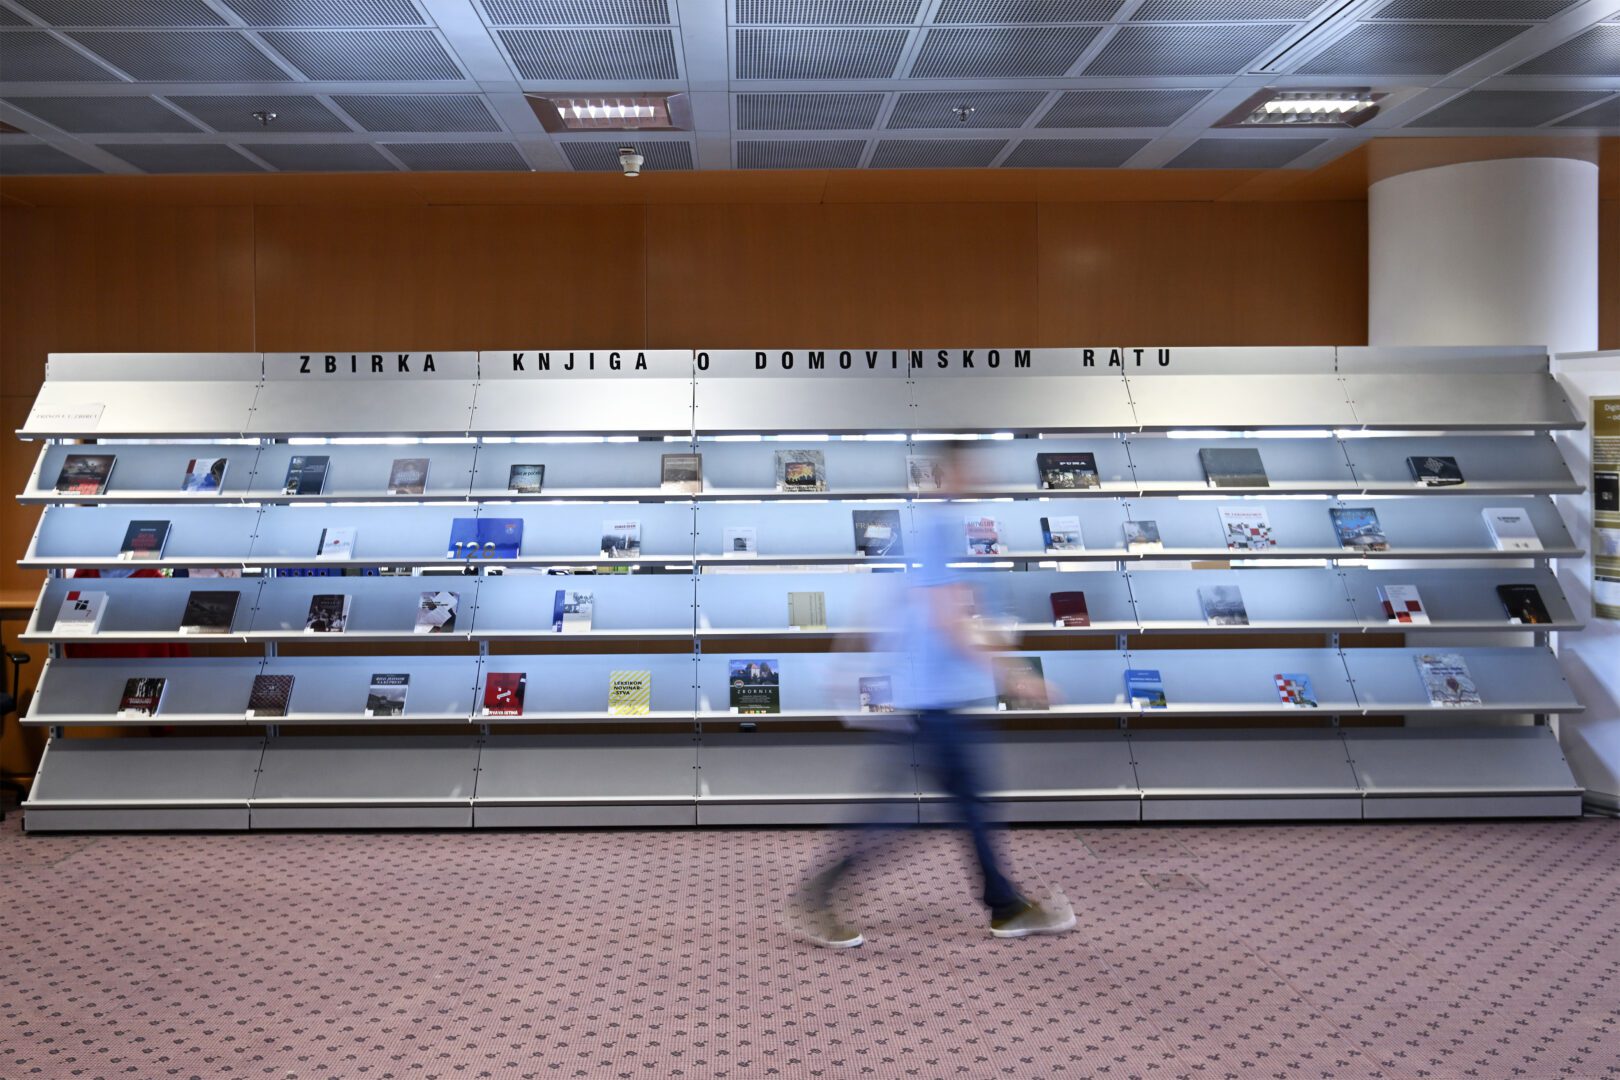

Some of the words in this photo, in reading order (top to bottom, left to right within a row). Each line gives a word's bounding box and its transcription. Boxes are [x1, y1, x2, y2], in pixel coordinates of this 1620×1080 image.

[299, 353, 436, 374] ZBIRKA
[512, 352, 648, 371] KNJIGA
[698, 352, 710, 371] O
[755, 349, 1031, 370] DOMOVINSKOM
[1083, 348, 1170, 367] RATU
